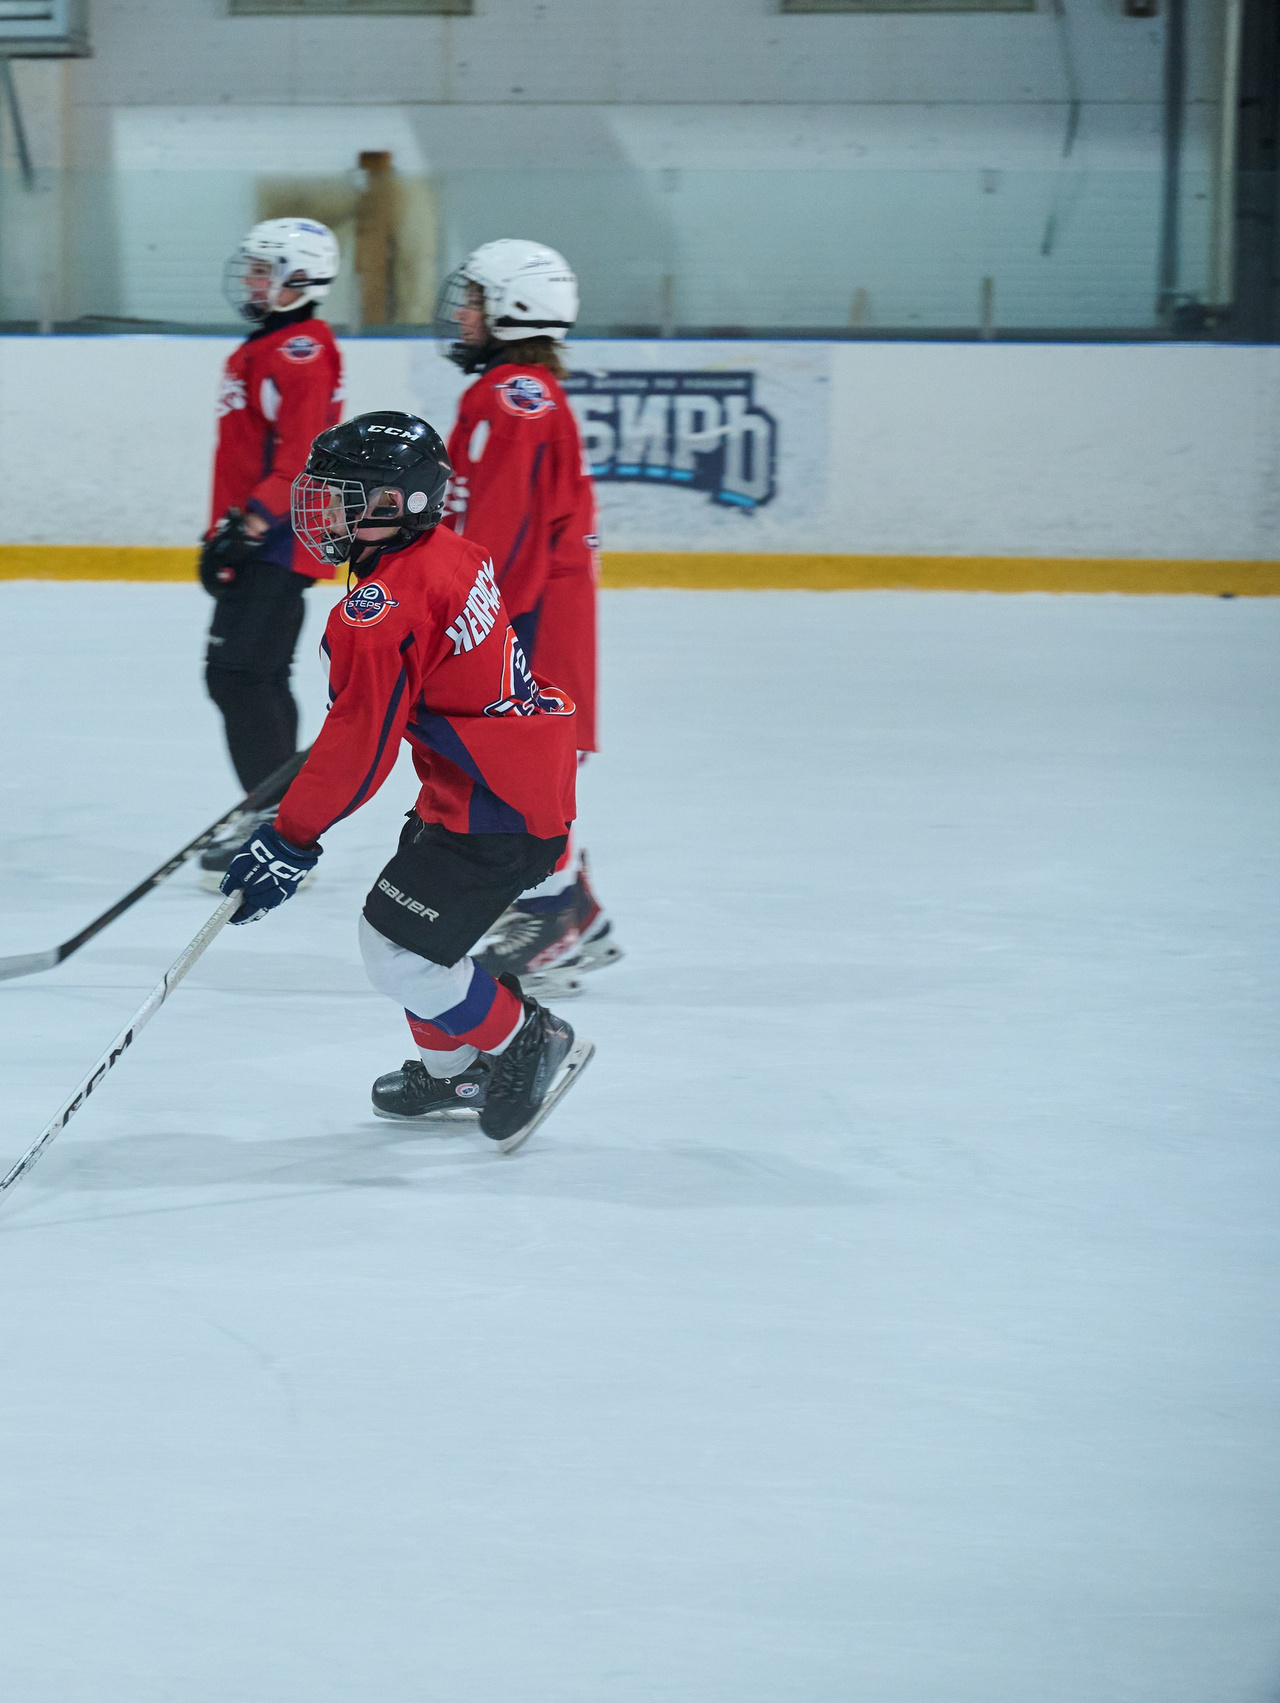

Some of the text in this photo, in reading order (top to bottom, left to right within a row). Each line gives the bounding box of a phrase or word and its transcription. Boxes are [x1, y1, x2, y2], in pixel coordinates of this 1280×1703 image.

[367, 424, 420, 441] CCM
[566, 393, 771, 501] БИРЬ
[357, 587, 379, 600] 10
[347, 599, 382, 610] STEPS
[377, 878, 440, 923] BAUER
